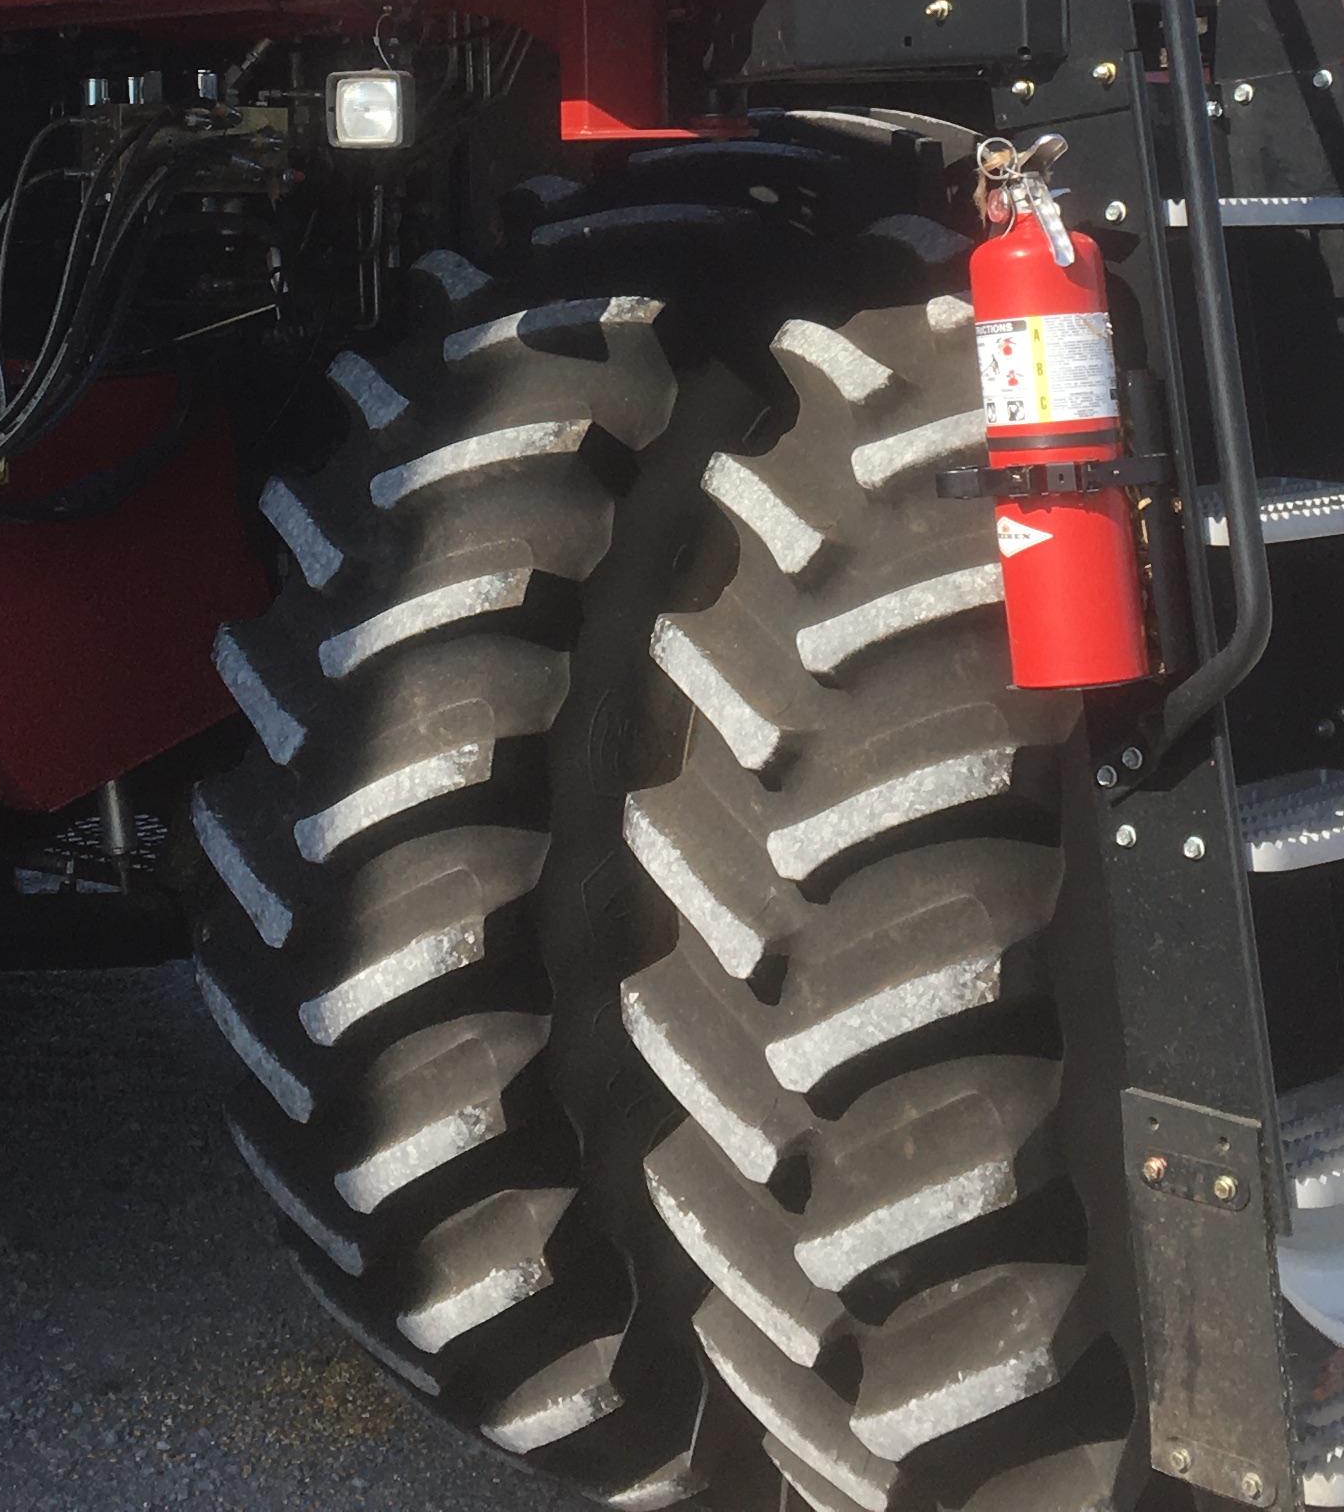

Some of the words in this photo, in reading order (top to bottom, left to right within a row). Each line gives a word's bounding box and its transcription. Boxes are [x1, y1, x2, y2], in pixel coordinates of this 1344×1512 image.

[1034, 329, 1040, 341] A
[1037, 363, 1043, 376] B
[1040, 396, 1047, 409] C
